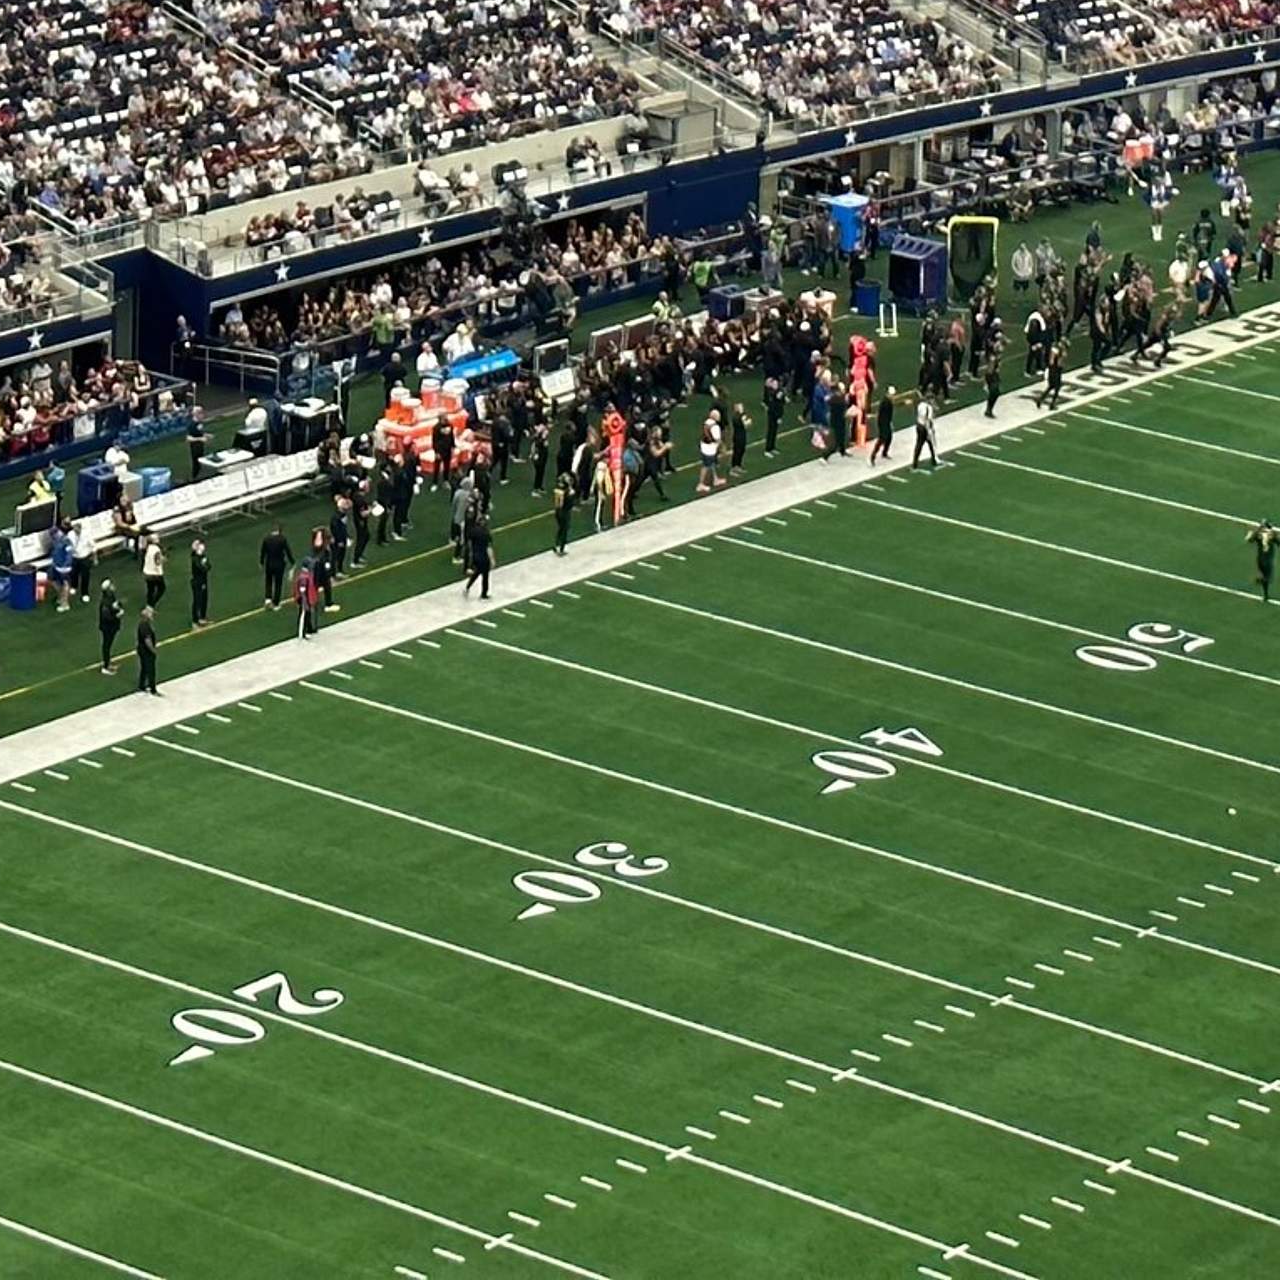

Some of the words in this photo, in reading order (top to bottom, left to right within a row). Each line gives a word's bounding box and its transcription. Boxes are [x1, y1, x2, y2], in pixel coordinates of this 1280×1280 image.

[1075, 622, 1214, 671] 50
[811, 726, 943, 780] 40
[512, 841, 670, 904] 30
[171, 972, 345, 1045] 20
